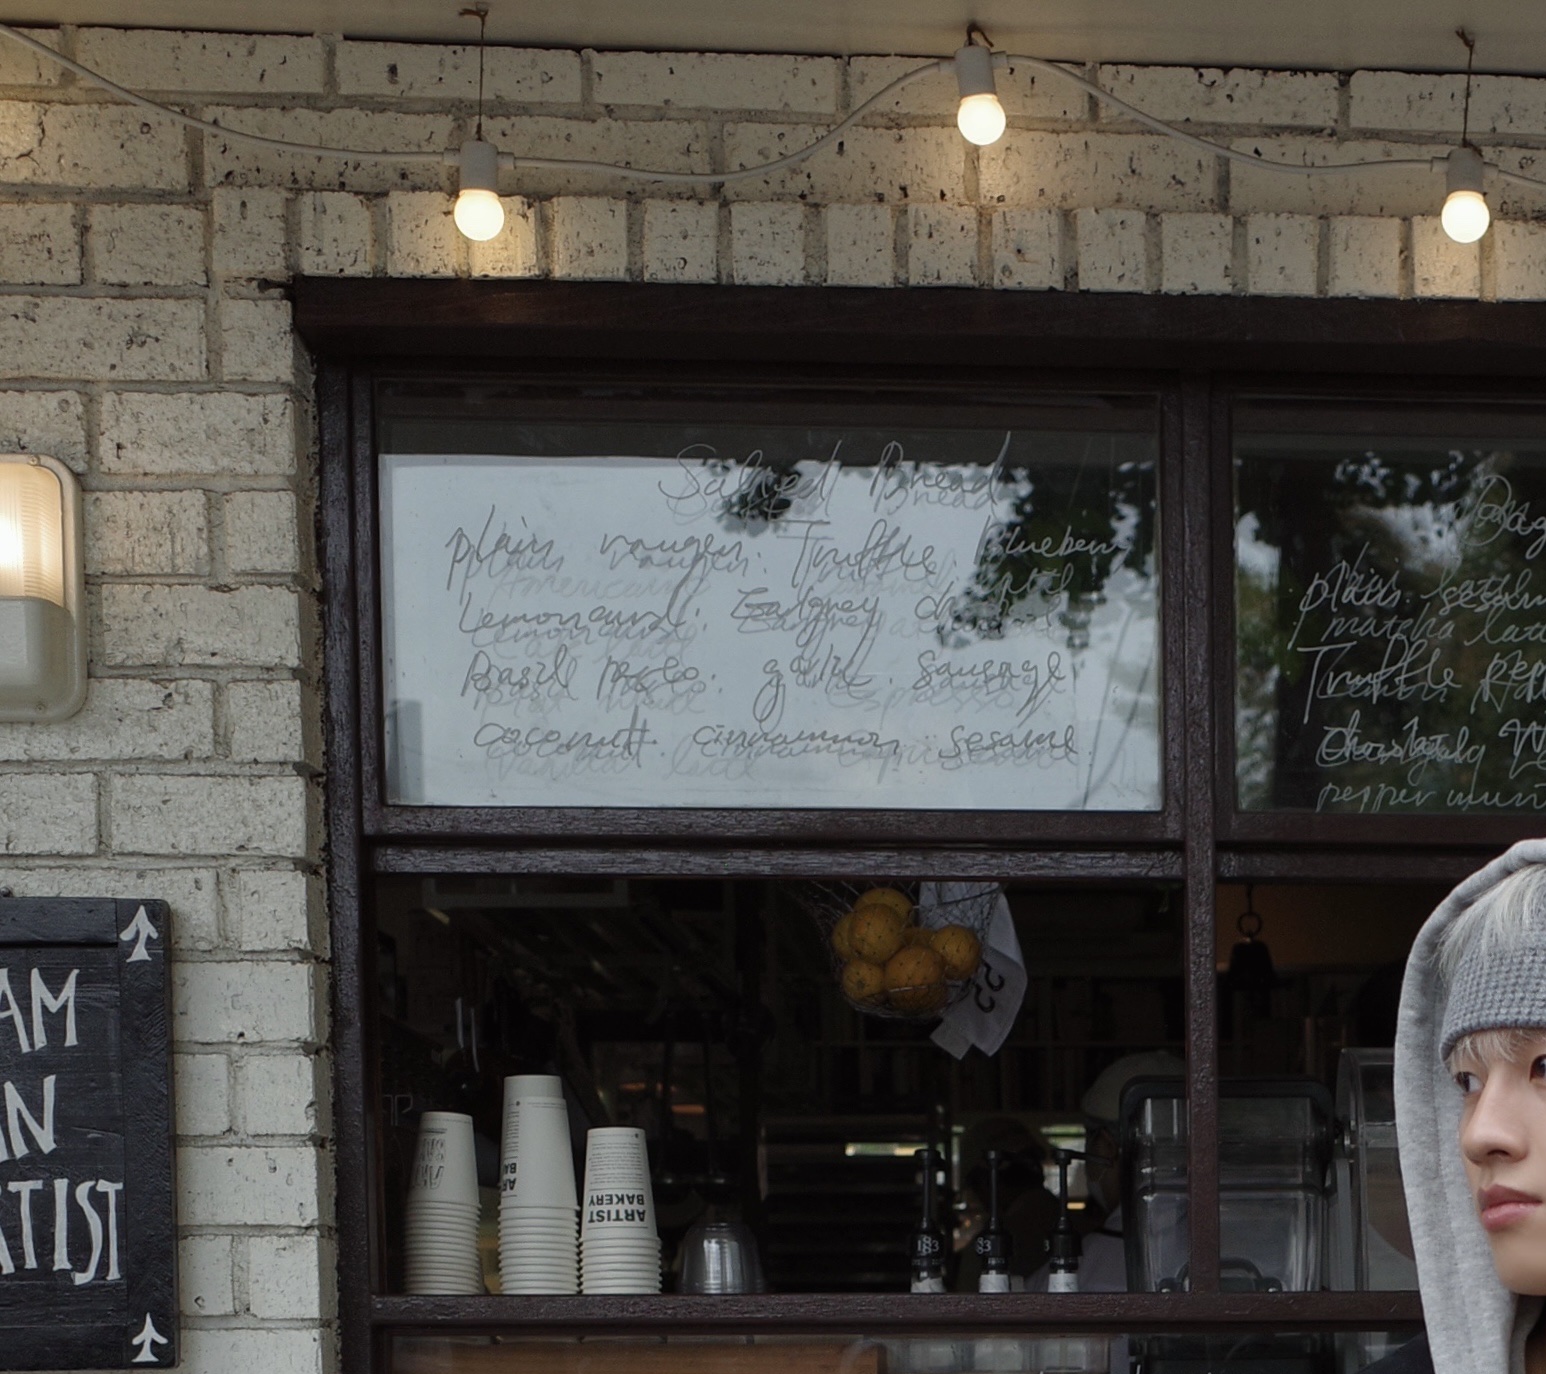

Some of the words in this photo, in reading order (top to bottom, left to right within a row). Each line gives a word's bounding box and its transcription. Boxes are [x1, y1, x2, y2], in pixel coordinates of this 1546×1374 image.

[870, 431, 1012, 502] Bread
[445, 504, 555, 591] plain
[0, 1074, 57, 1162] N
[587, 1209, 646, 1223] ARTIST
[588, 1194, 645, 1206] BAKERY
